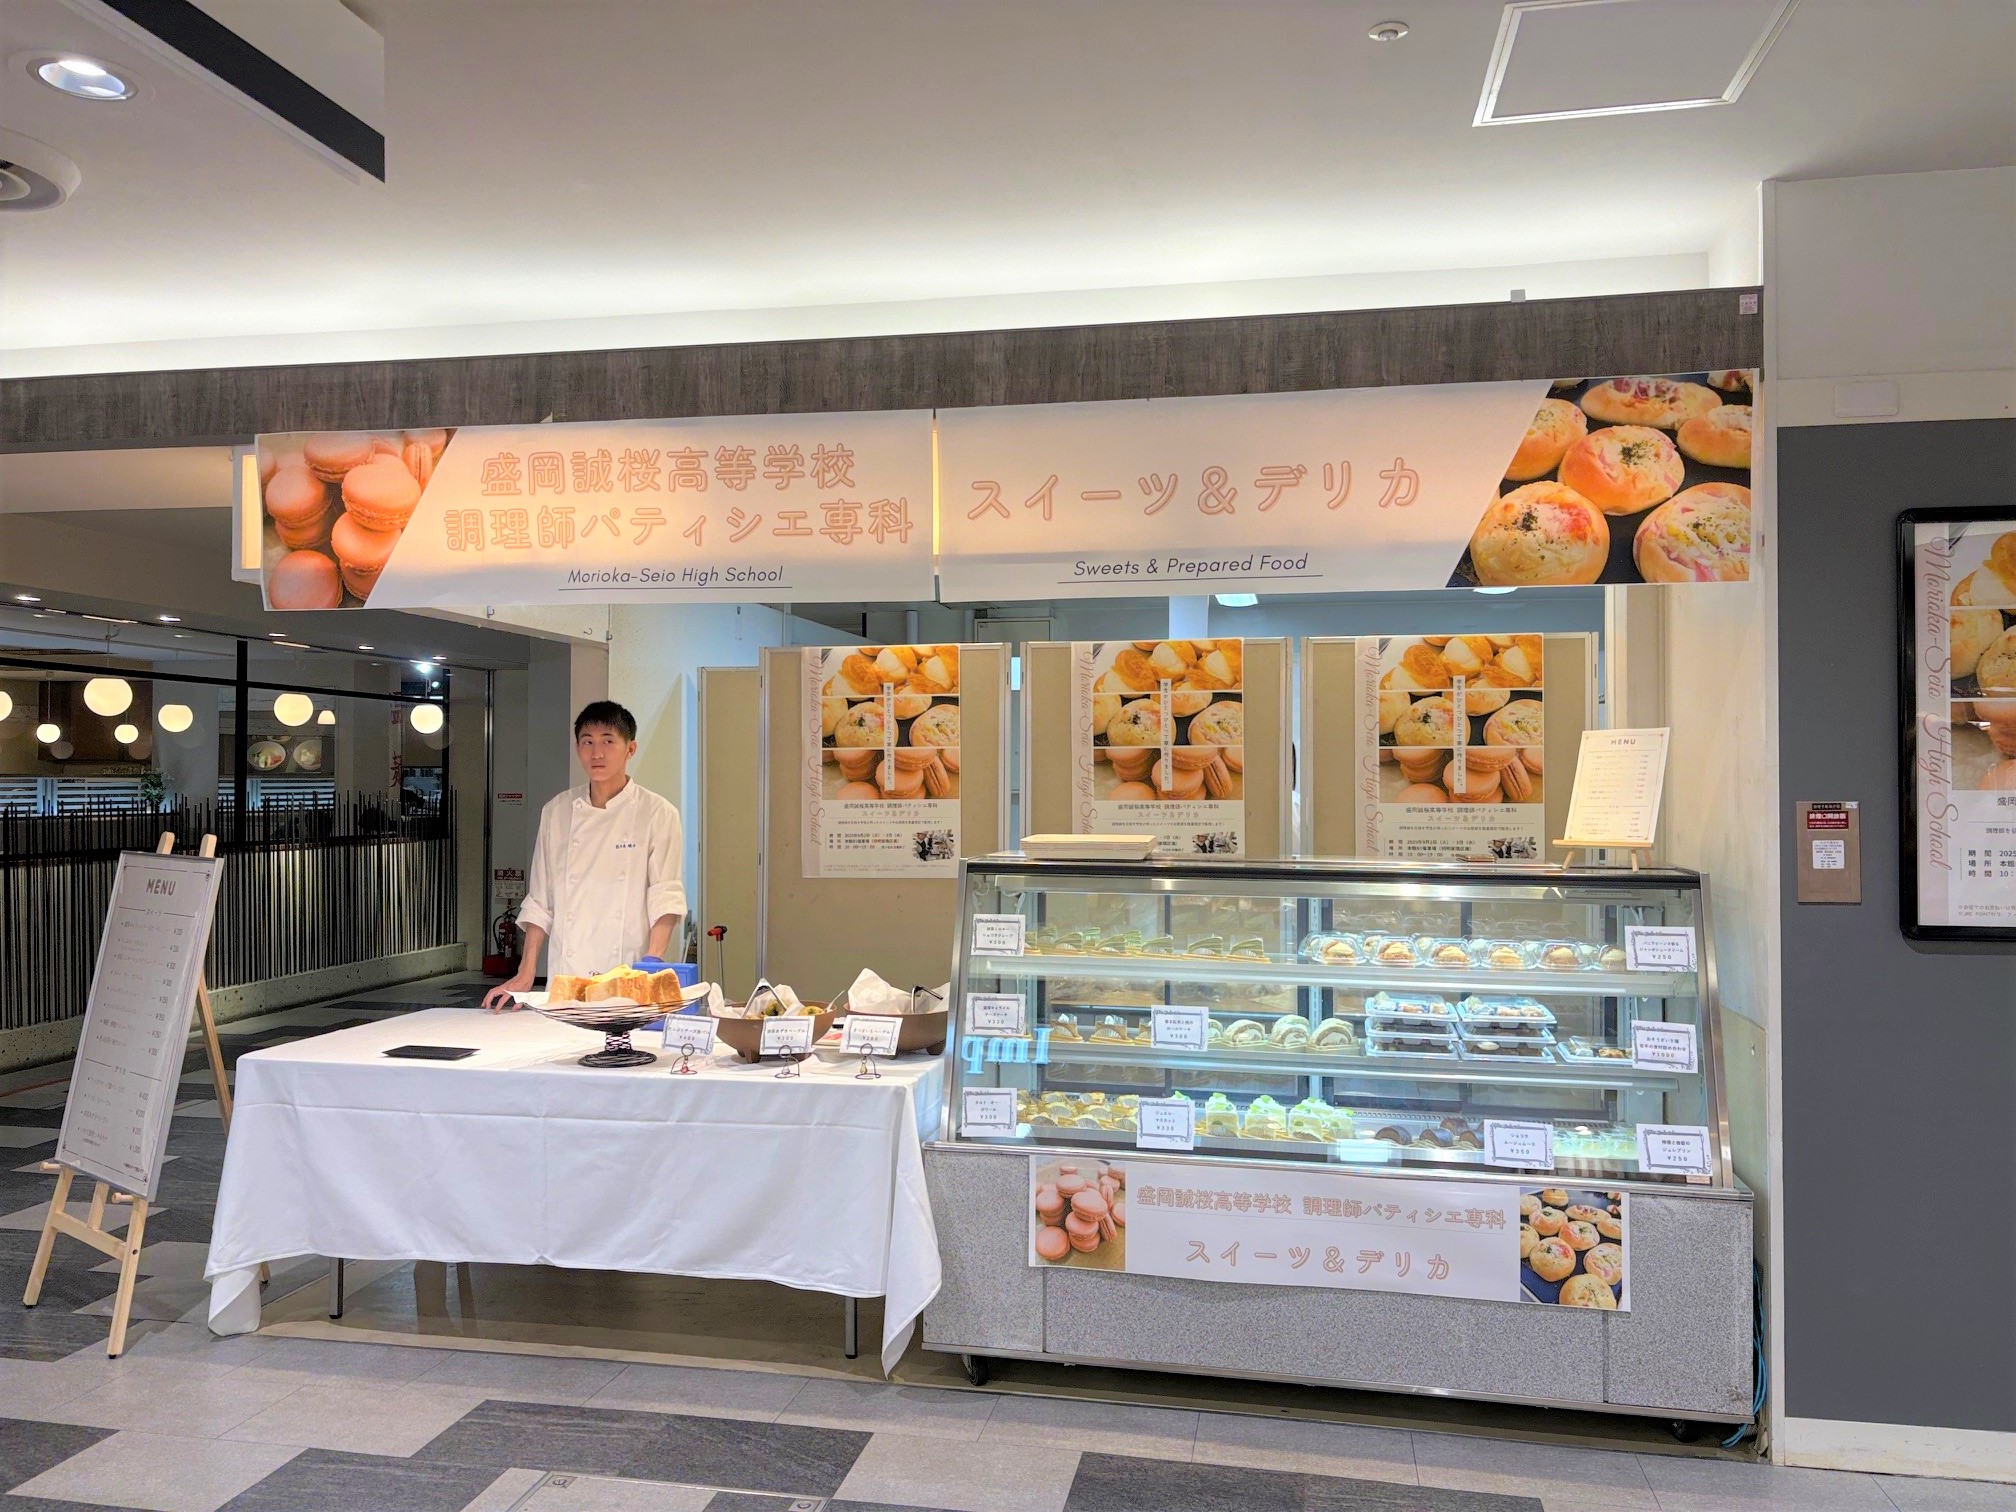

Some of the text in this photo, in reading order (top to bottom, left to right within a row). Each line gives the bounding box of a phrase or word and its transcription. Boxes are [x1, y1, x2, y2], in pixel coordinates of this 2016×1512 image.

[480, 443, 856, 498] 盛岡誠桜高等学校
[443, 497, 914, 552] 調理師パティシエ専科
[567, 565, 783, 587] Morioka-Seio High School
[1073, 552, 1309, 578] Sweets & Prepared Food
[145, 878, 177, 897] MENU
[1135, 1185, 1507, 1231] 盛岡誠桜高等学校 調理師パティシエ専科
[1186, 1238, 1452, 1282] スイーツ&デリカ
